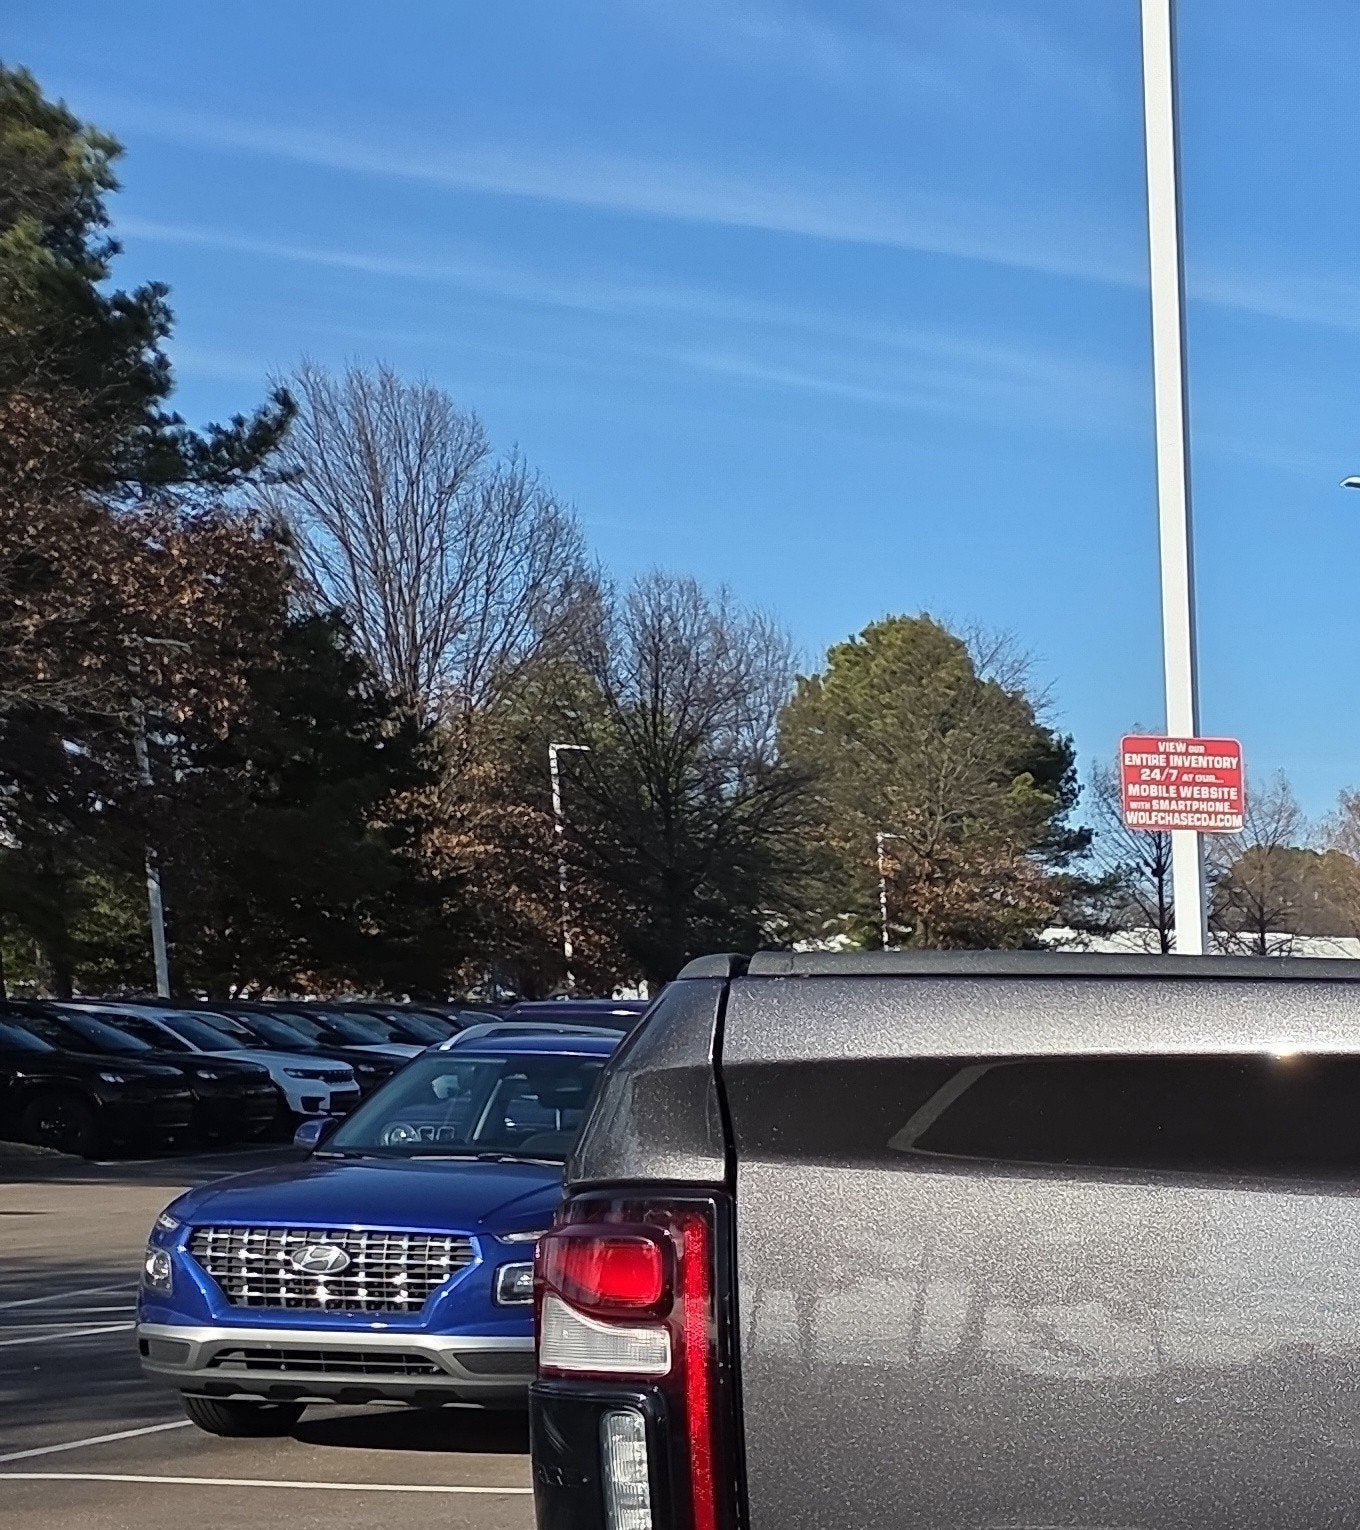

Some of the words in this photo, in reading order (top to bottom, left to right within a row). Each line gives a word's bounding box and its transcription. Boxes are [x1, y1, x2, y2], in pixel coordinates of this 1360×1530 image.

[1158, 741, 1187, 753] VIEW
[1188, 745, 1204, 753] OUR
[1124, 753, 1167, 767] ENTIRE
[1169, 755, 1238, 769] INVENTORY
[1140, 768, 1178, 782] 24/7
[1181, 773, 1194, 782] AT
[1127, 784, 1177, 797] MOBILE
[1179, 786, 1238, 799] WEBSITE
[1129, 801, 1150, 810] WITH
[1126, 811, 1243, 827] WOLFCHASECDJ.COM
